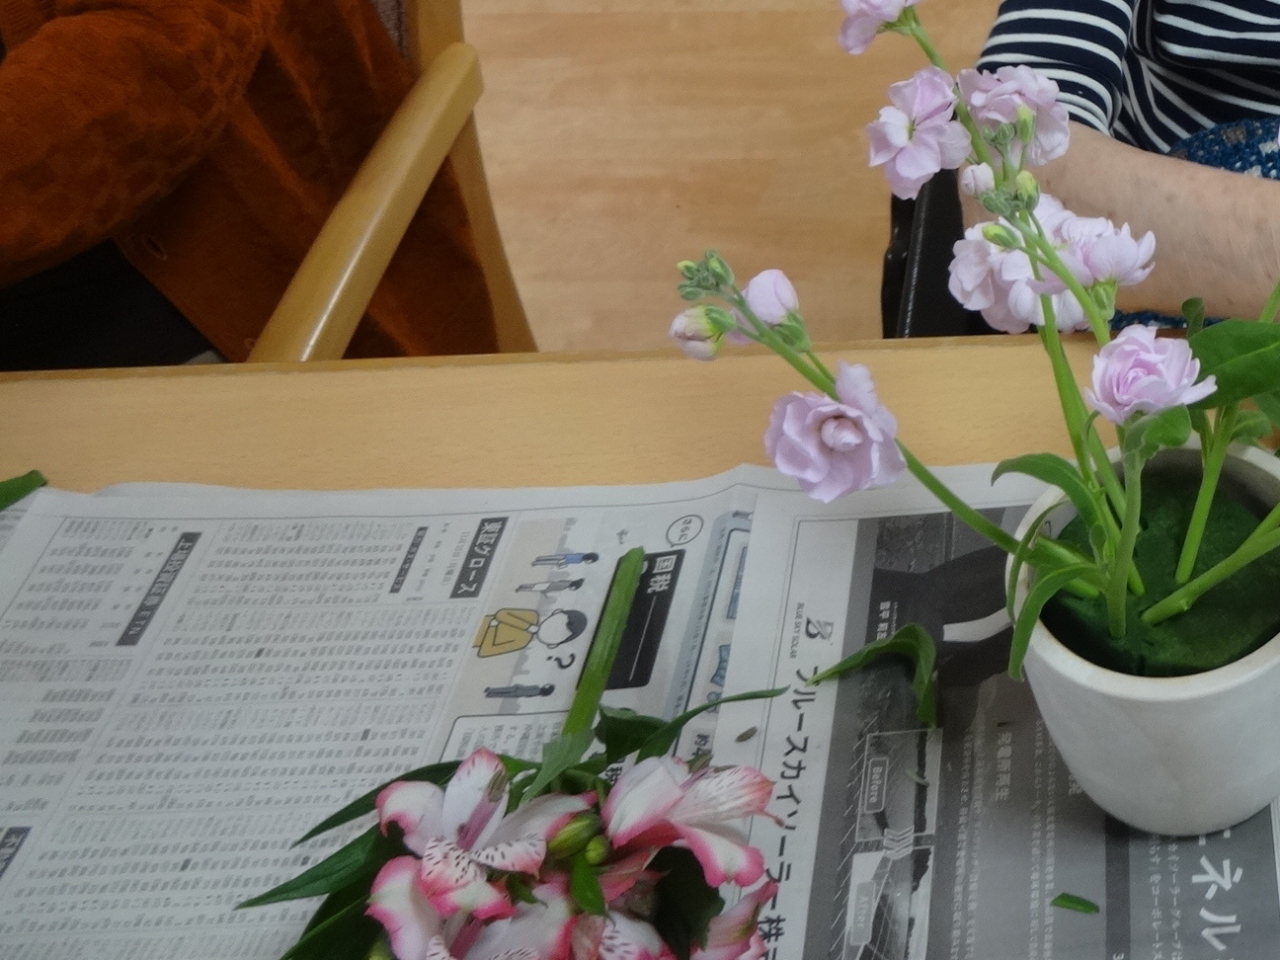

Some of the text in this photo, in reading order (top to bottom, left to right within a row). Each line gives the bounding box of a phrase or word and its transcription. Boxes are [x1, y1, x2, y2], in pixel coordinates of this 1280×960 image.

[456, 520, 504, 595] 東証グロース
[646, 553, 679, 595] 国税
[867, 765, 883, 804] Before
[855, 895, 869, 929] After
[1167, 837, 1184, 960] カイソーラーグループは
[1190, 828, 1244, 960] ネル
